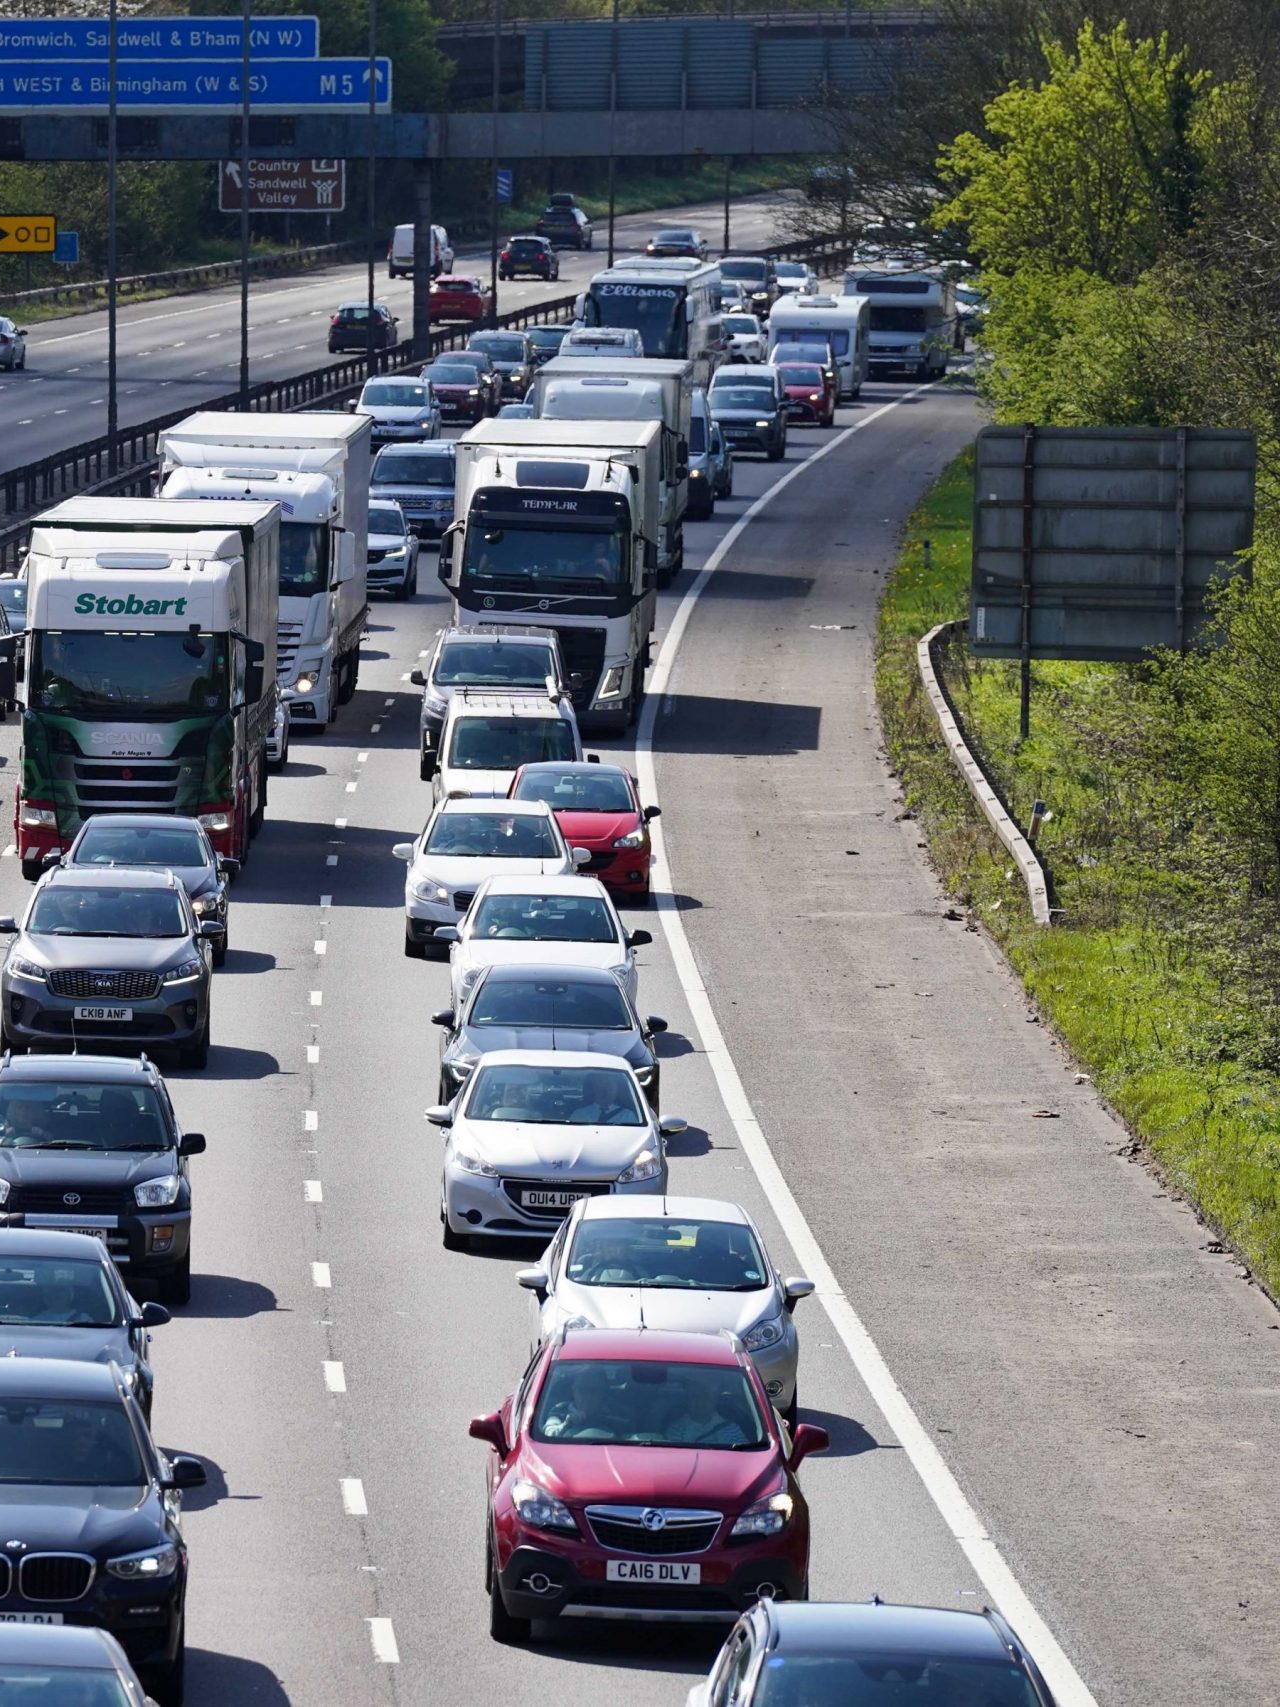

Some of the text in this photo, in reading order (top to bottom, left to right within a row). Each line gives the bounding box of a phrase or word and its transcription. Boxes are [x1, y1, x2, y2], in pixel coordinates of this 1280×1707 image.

[170, 31, 182, 46] &
[14, 78, 63, 92] WEST
[71, 78, 83, 92] &
[91, 77, 187, 95] Birmingham
[195, 76, 220, 93] (W
[229, 77, 241, 91] &
[248, 161, 300, 173] Country
[248, 178, 307, 189] Sandwell
[257, 192, 297, 205] Valley
[522, 499, 578, 510] TEMPLAR
[74, 593, 187, 616] Stobart
[91, 731, 165, 745] SCANIA
[107, 1009, 126, 1019] ANF
[617, 1562, 690, 1581] CA16 DLV
